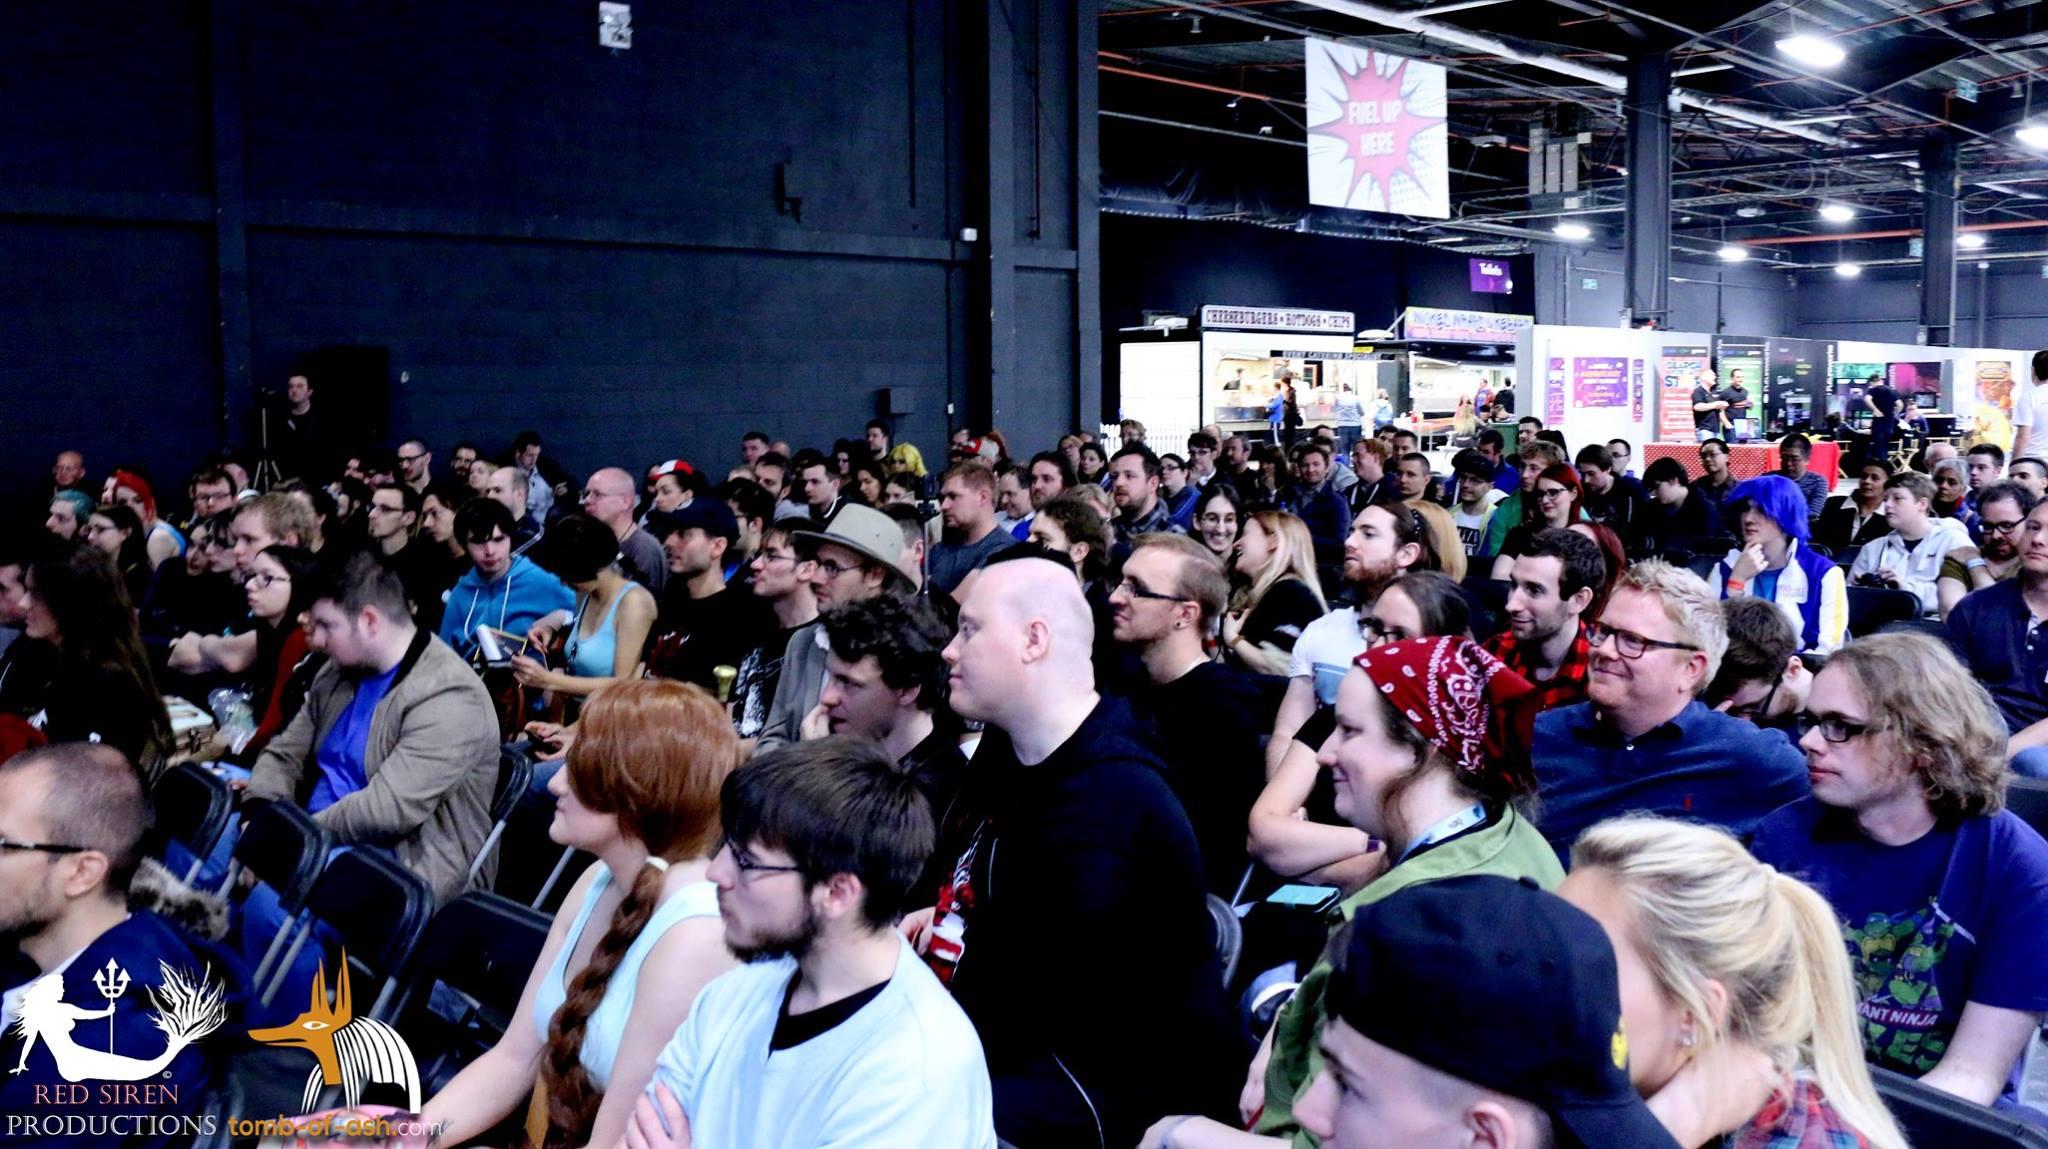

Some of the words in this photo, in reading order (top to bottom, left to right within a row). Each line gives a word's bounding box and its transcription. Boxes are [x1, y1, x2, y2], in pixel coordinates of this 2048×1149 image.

[1348, 101, 1380, 125] FUEL
[1382, 100, 1402, 124] UP
[1360, 132, 1395, 156] HERE
[1479, 262, 1503, 276] Toilets
[1206, 309, 1278, 326] CHEESEBURGERS
[1285, 312, 1321, 327] HOTDOGS
[1328, 315, 1351, 328] CHIPS
[1890, 1009, 1938, 1026] NINJA
